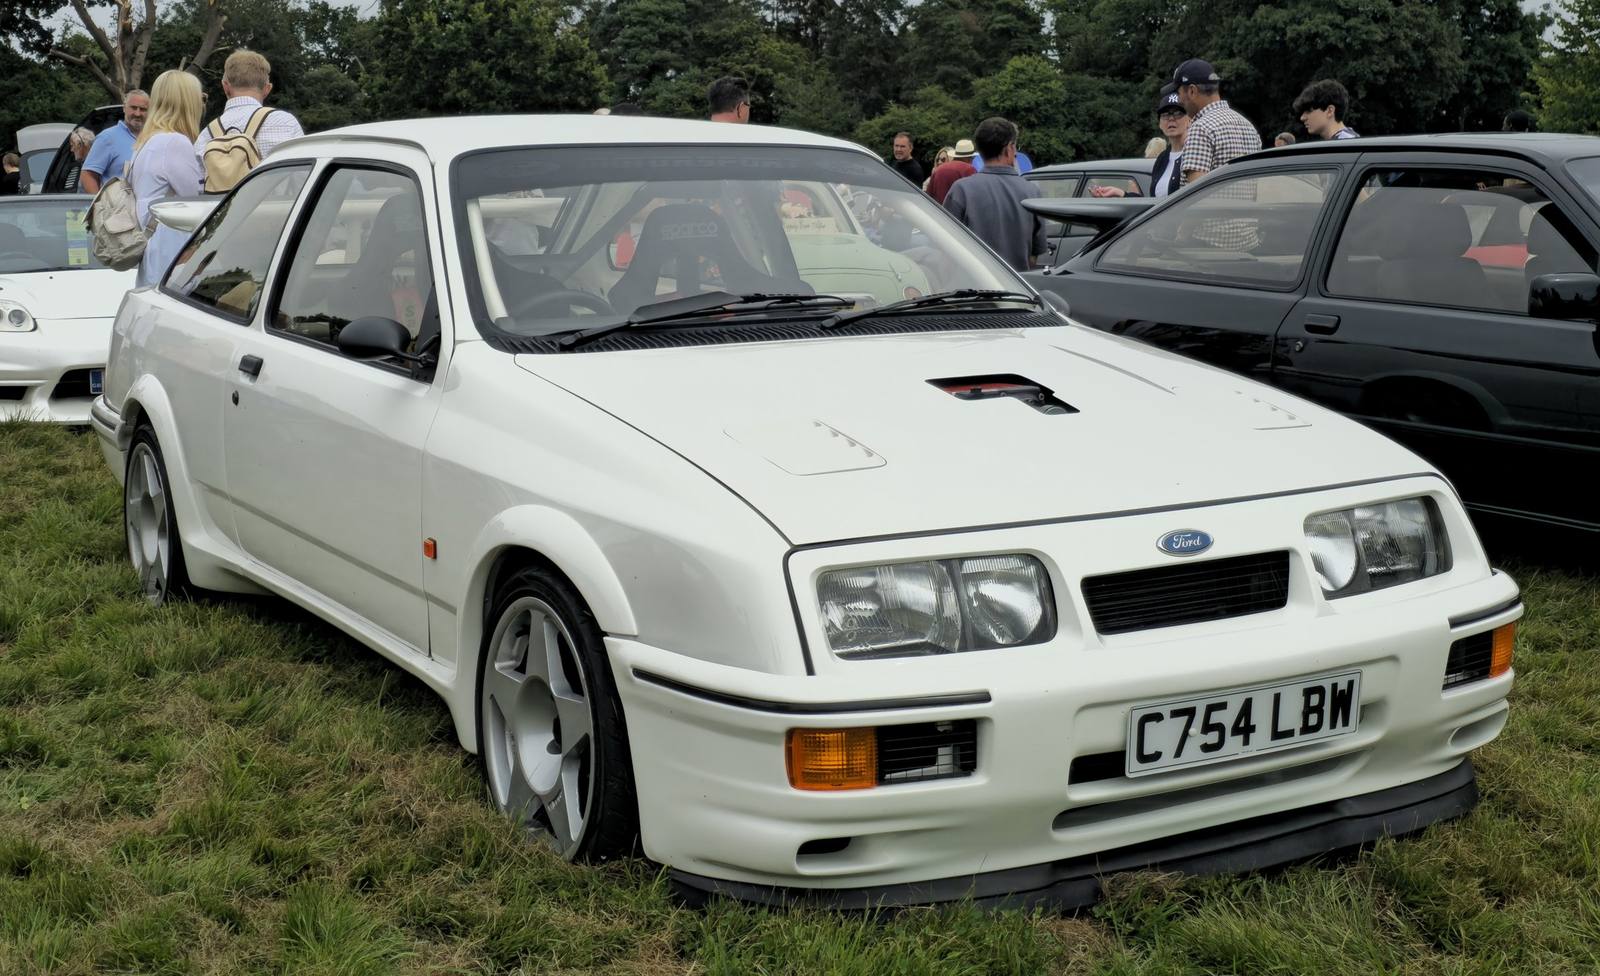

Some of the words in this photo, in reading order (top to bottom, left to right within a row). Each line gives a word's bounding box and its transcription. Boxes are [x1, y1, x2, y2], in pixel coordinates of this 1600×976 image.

[1172, 533, 1202, 549] Ford
[1136, 697, 1256, 764] C754
[1270, 679, 1355, 741] LBW
